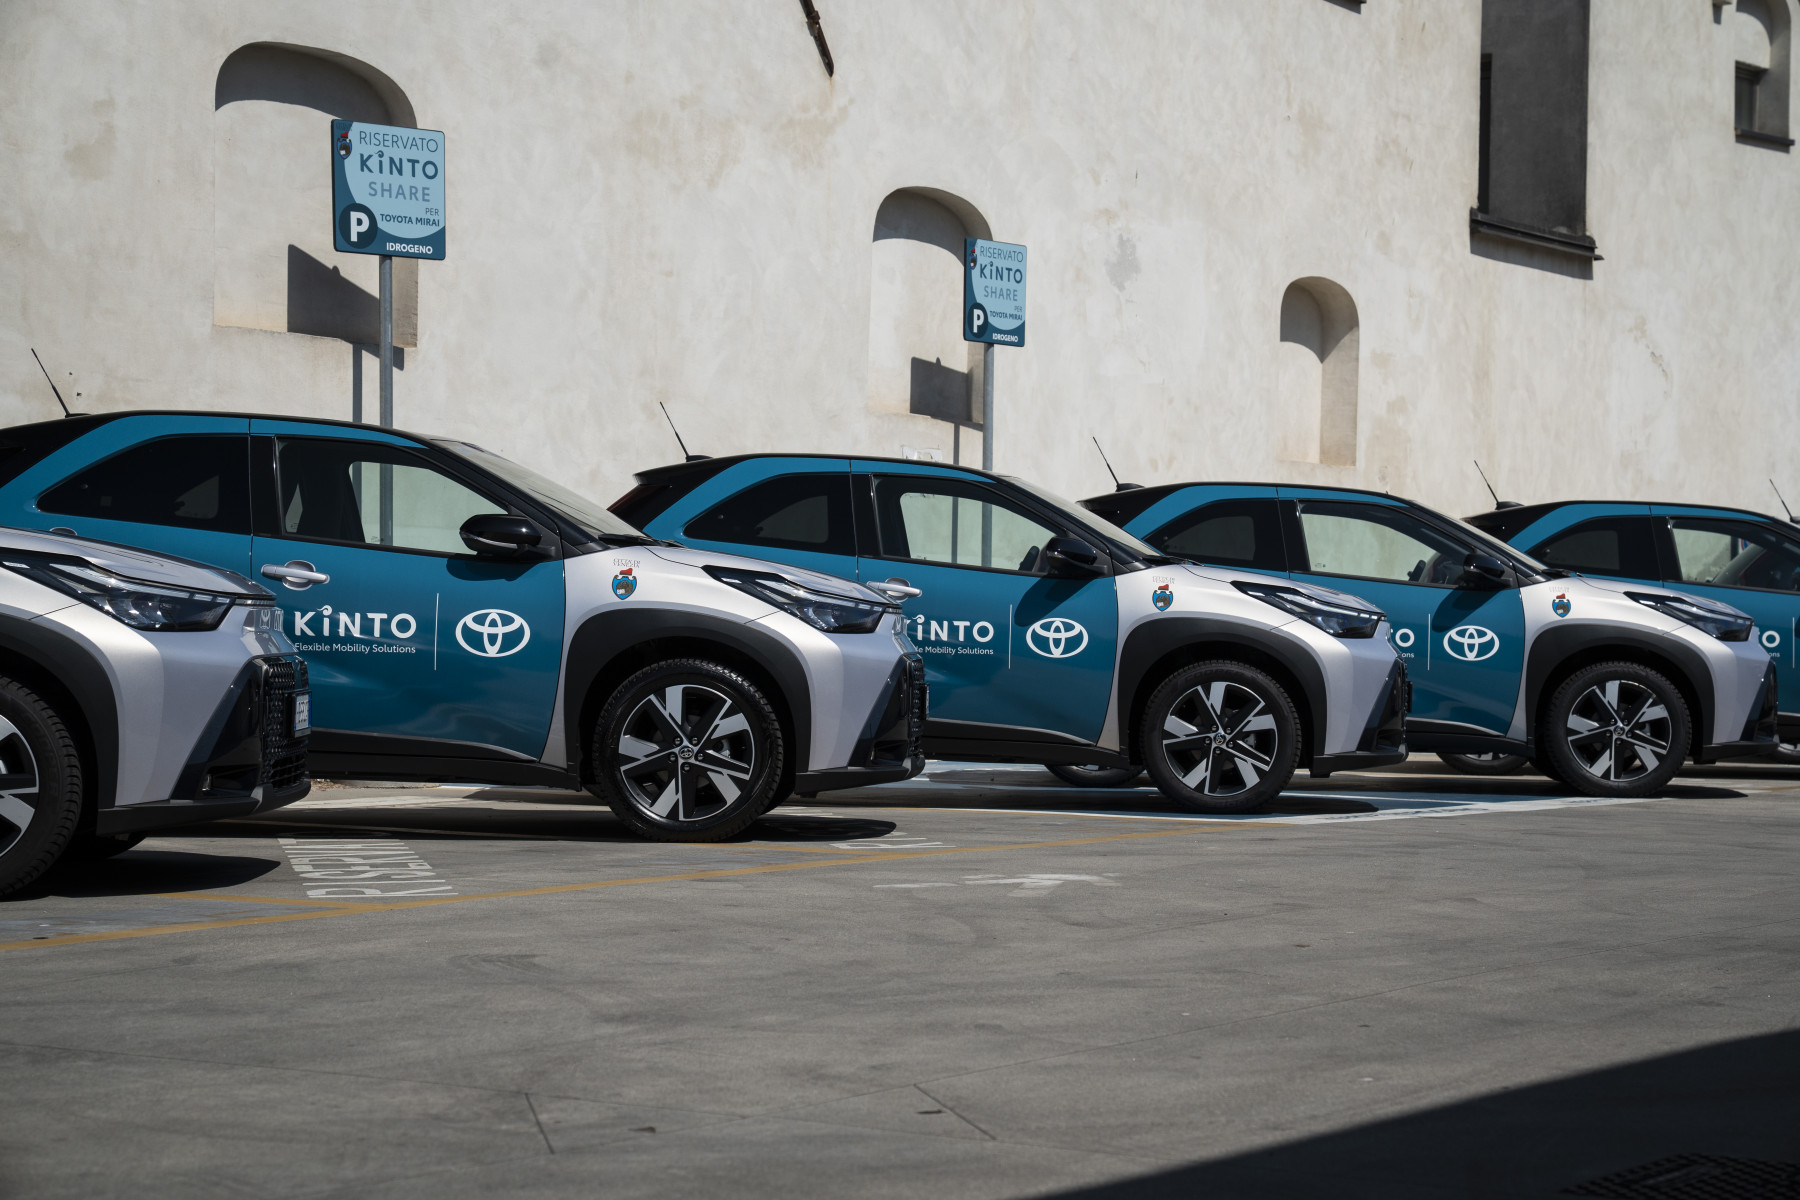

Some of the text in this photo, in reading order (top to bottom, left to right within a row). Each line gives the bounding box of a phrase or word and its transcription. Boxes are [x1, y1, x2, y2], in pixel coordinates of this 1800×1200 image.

[359, 130, 439, 153] RISERVATO
[368, 181, 431, 203] SHARE
[425, 207, 440, 217] PER
[349, 210, 370, 243] P
[380, 213, 440, 227] TOYOTA MIRAI
[386, 241, 433, 255] IDROGENO
[980, 245, 1024, 263] RISERVATO
[983, 285, 1018, 302] SHARE
[973, 308, 985, 334] P
[989, 310, 1023, 321] TOYOTA MIRAI
[992, 332, 1019, 343] IDROGENO
[294, 642, 417, 655] Flexible Mobility Solutions
[925, 646, 956, 656] Mobility
[957, 646, 995, 655] Solutions
